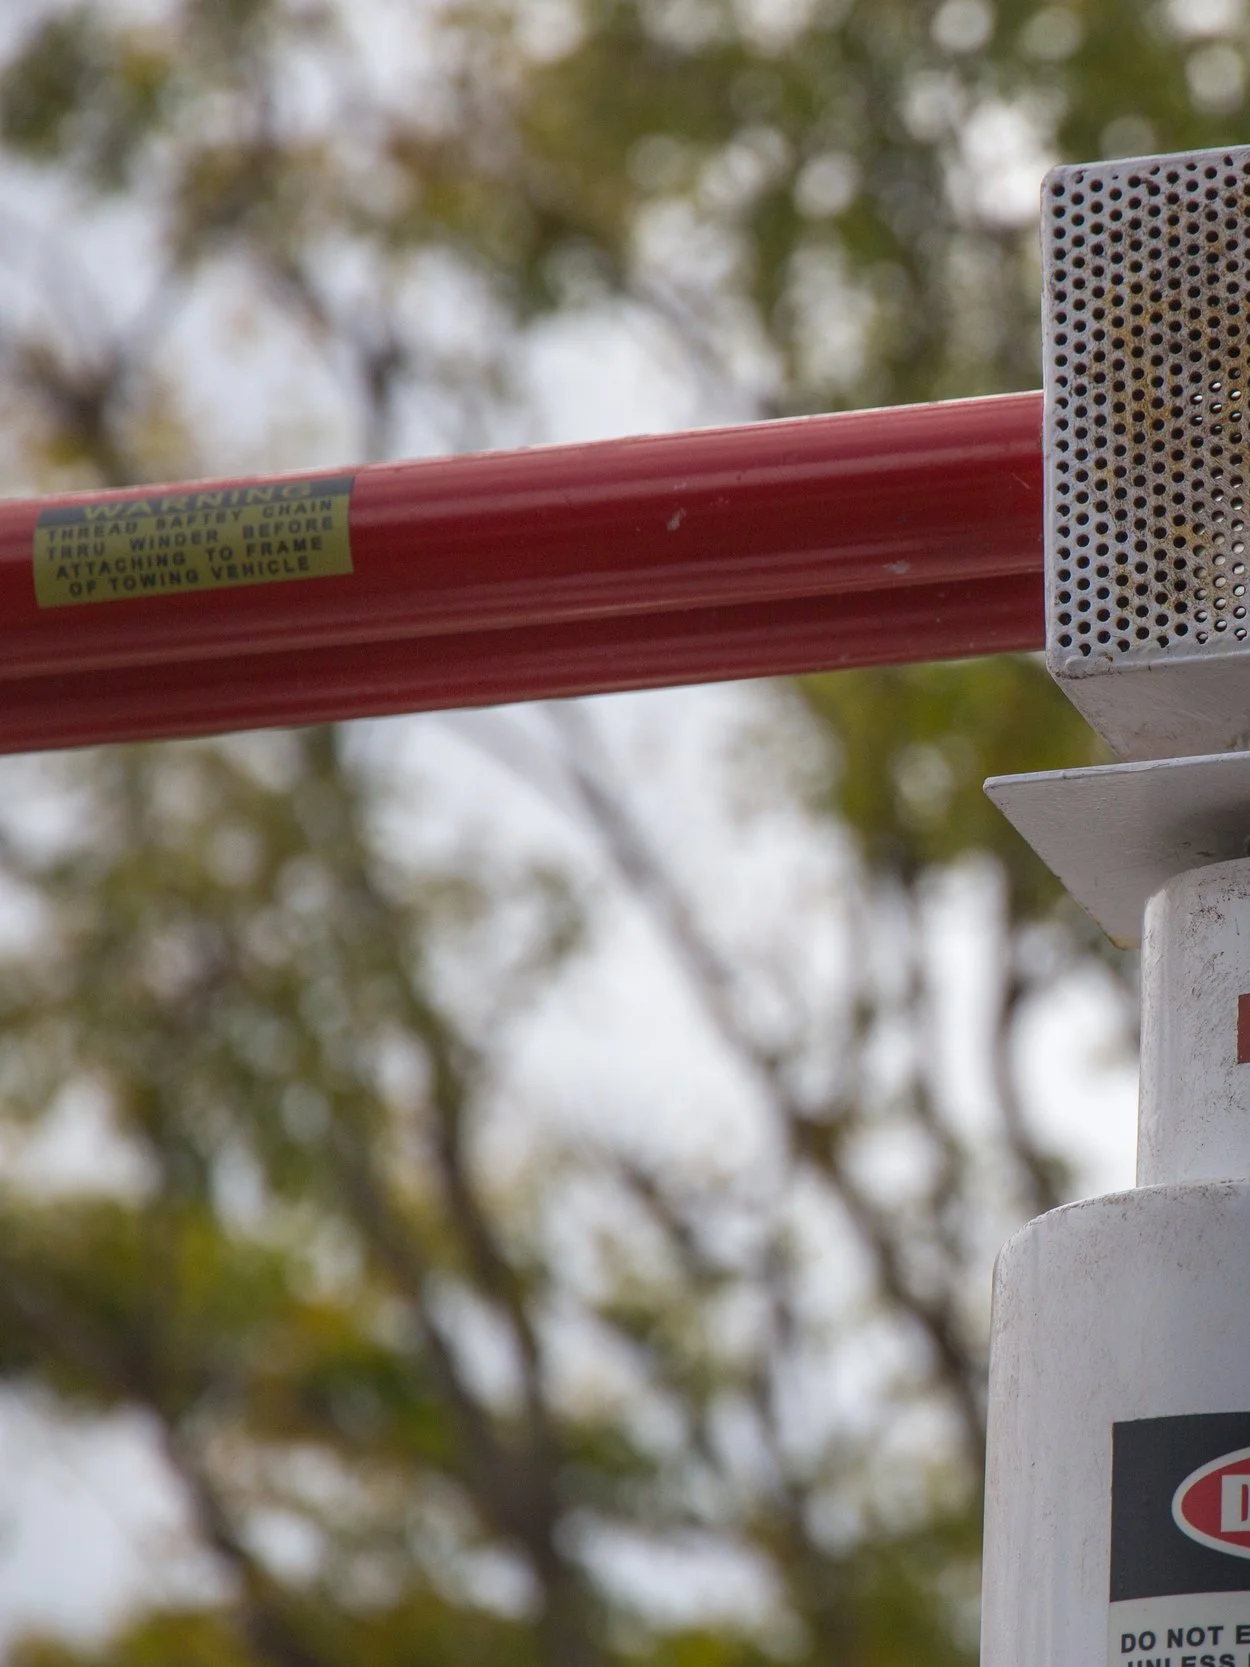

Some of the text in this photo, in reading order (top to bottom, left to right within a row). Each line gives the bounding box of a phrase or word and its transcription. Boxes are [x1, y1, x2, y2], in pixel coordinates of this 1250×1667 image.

[47, 520, 138, 542] THREAD
[262, 499, 332, 519] CHAIN
[84, 483, 311, 520] WARNING
[46, 515, 333, 561] THRU WINDER BEFORE
[56, 535, 322, 580] ATTACHING TO FRAME
[69, 555, 309, 597] OF TOWING VEHICLE
[1121, 1631, 1156, 1653] DO
[1167, 1625, 1224, 1648] NOT
